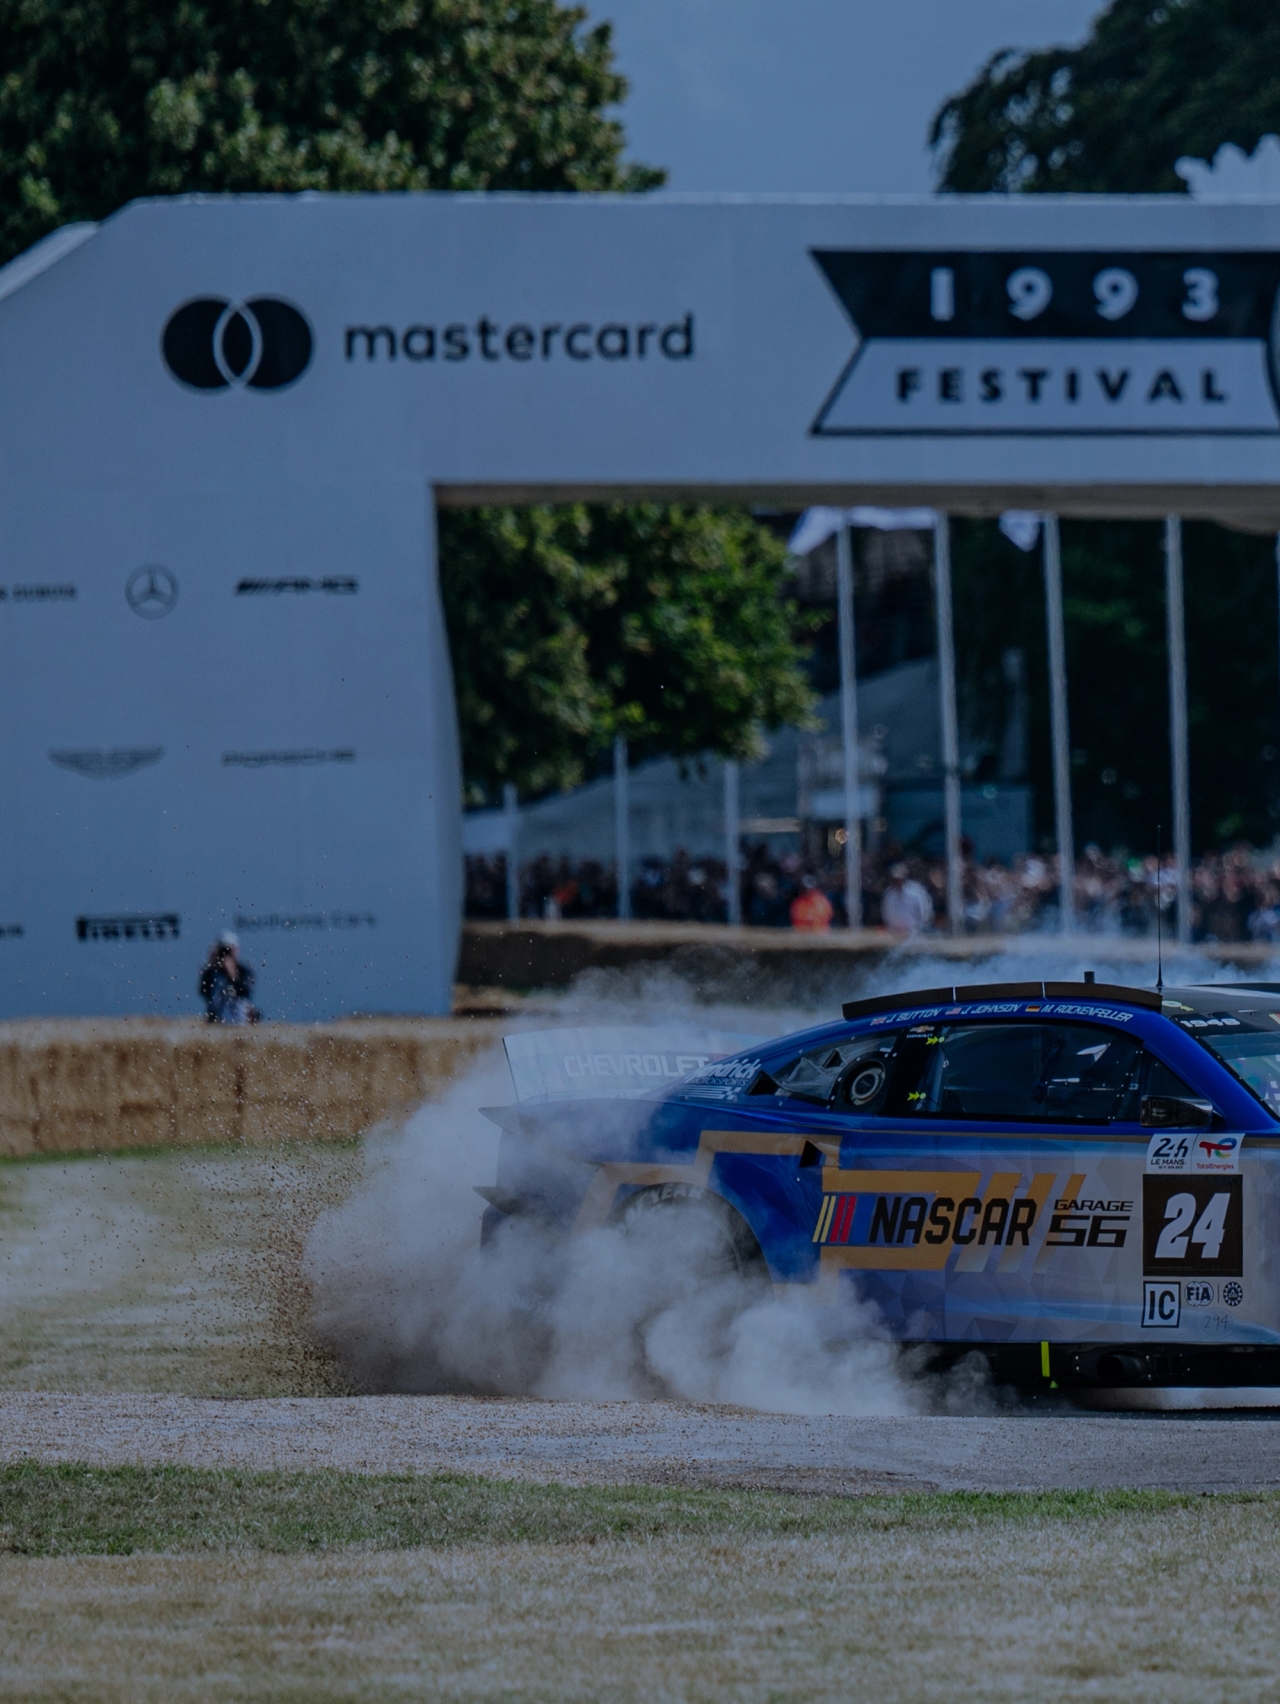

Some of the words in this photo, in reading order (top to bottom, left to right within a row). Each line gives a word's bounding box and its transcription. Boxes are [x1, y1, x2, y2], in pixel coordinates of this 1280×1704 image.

[930, 266, 1220, 322] 1993
[345, 314, 695, 361] mastercard
[899, 368, 1225, 402] FESTIVAL
[897, 1008, 942, 1022] BUTTON
[971, 1004, 1022, 1014] JOHNSON
[1051, 1004, 1134, 1023] ROCKENFELLER
[563, 1054, 710, 1078] CHEVROLET
[1196, 1163, 1234, 1171] TotalEnergies
[1054, 1200, 1134, 1212] GARAGE
[869, 1197, 1037, 1246] NASCAR
[1046, 1215, 1130, 1248] 56
[1154, 1192, 1231, 1260] 24
[1148, 1290, 1175, 1320] IC
